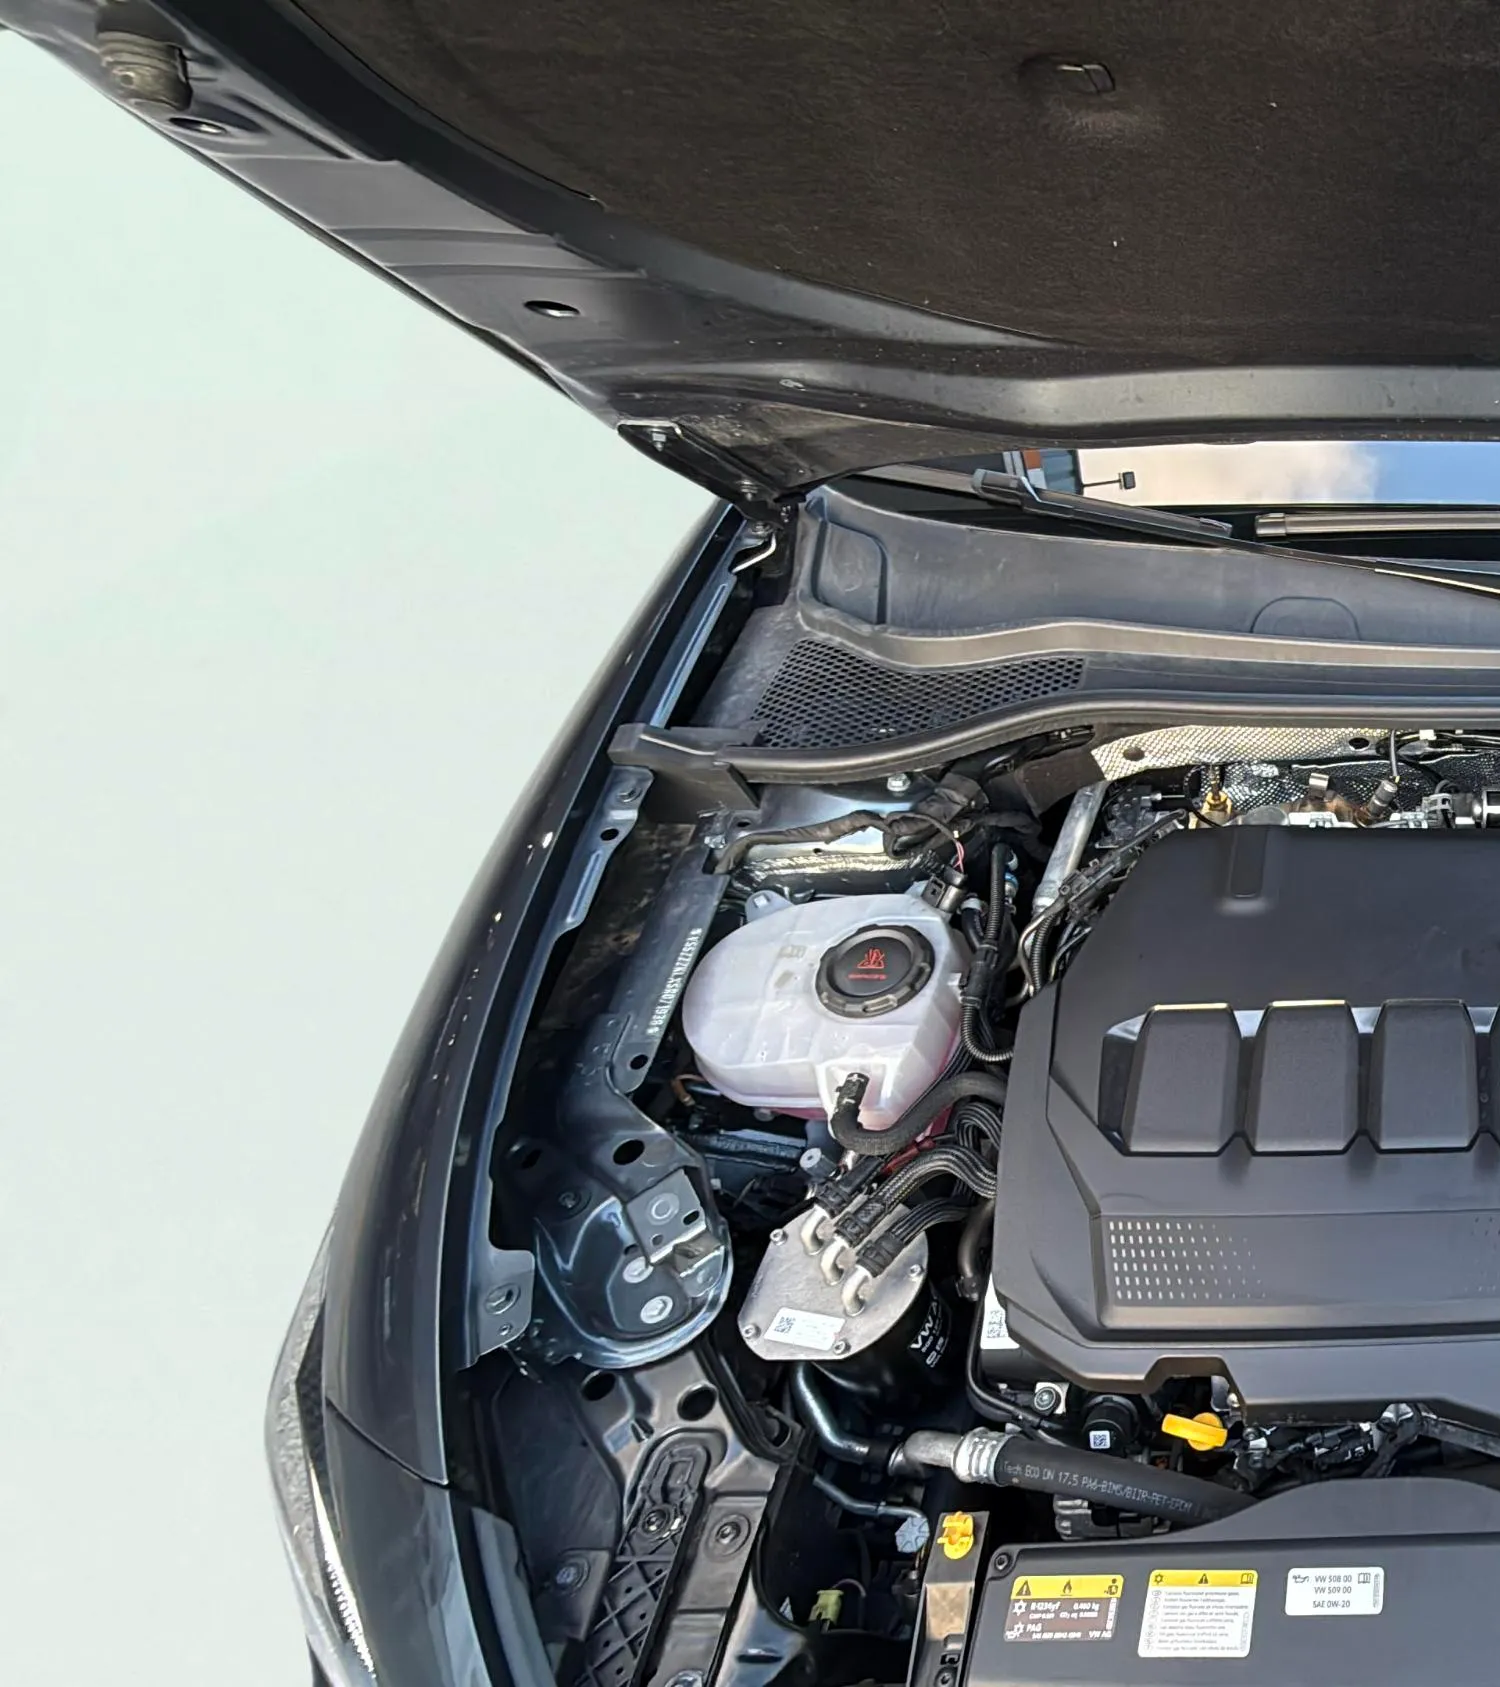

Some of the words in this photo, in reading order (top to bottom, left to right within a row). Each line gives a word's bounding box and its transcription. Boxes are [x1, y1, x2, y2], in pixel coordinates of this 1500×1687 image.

[910, 1315, 934, 1349] VW
[1314, 1575, 1327, 1583] VW
[1328, 1575, 1342, 1583] 508
[1343, 1575, 1352, 1583] 00
[1313, 1586, 1326, 1594] VW
[1327, 1586, 1341, 1594] 509
[1342, 1586, 1352, 1594] 00
[1313, 1600, 1325, 1608] SAE
[1326, 1600, 1350, 1608] 0W-20
